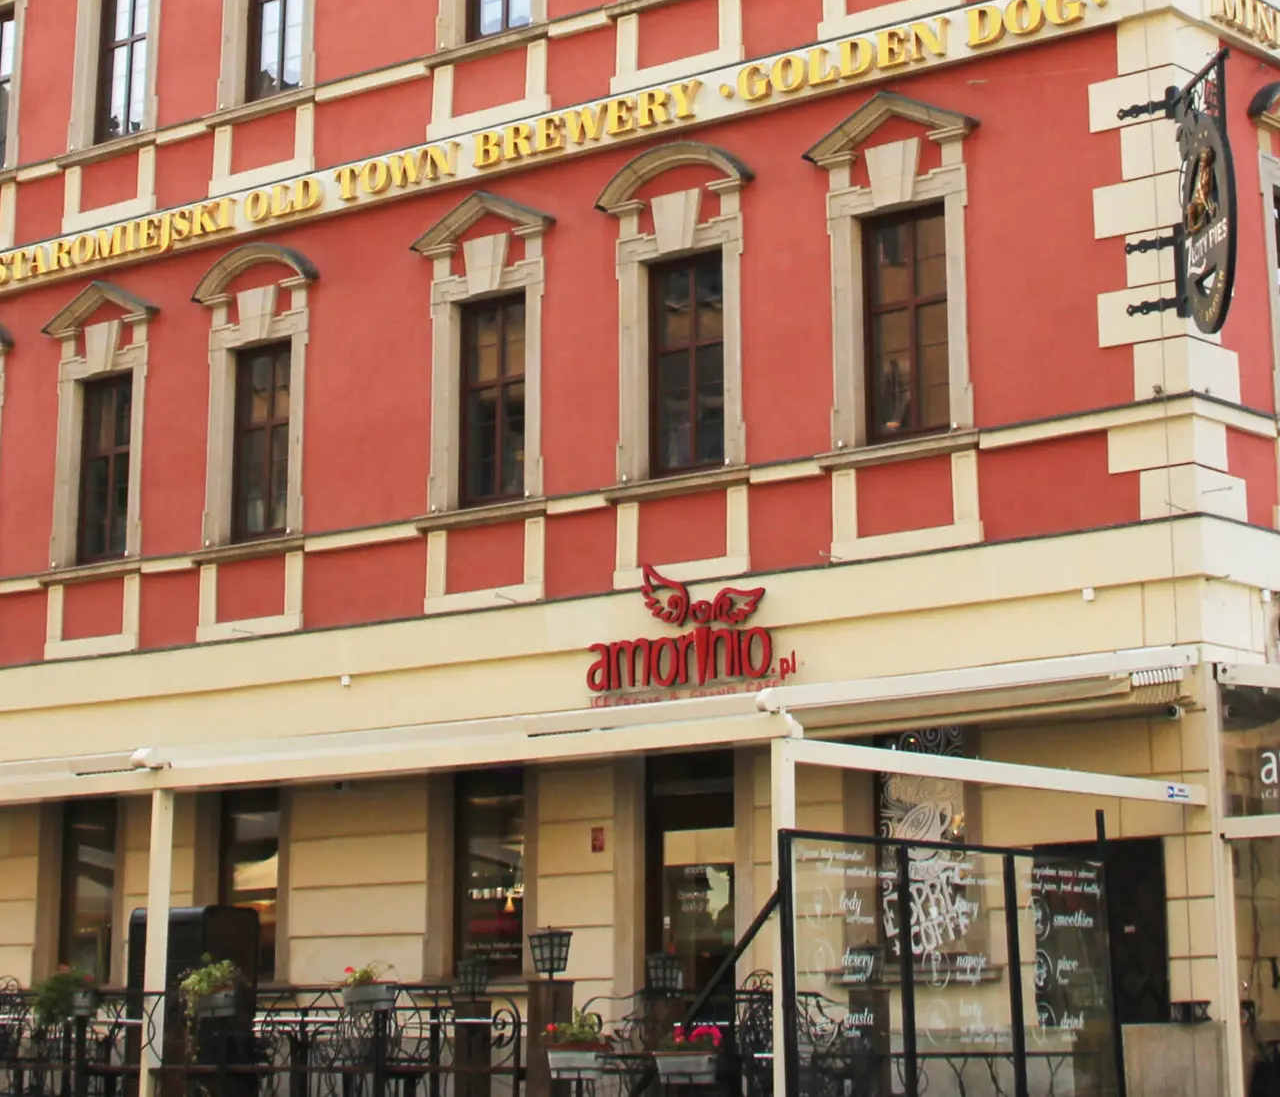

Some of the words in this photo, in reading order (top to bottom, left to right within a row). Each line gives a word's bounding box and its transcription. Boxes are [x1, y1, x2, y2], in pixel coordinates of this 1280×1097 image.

[244, 178, 323, 223] OLD
[334, 141, 459, 201] TOWN
[472, 80, 704, 169] BREWERY
[737, 16, 950, 101] GOLDEN
[1261, 789, 1278, 800] ICE
[841, 946, 875, 977] desery
[955, 952, 988, 976] napoje
[1060, 1010, 1085, 1031] drink
